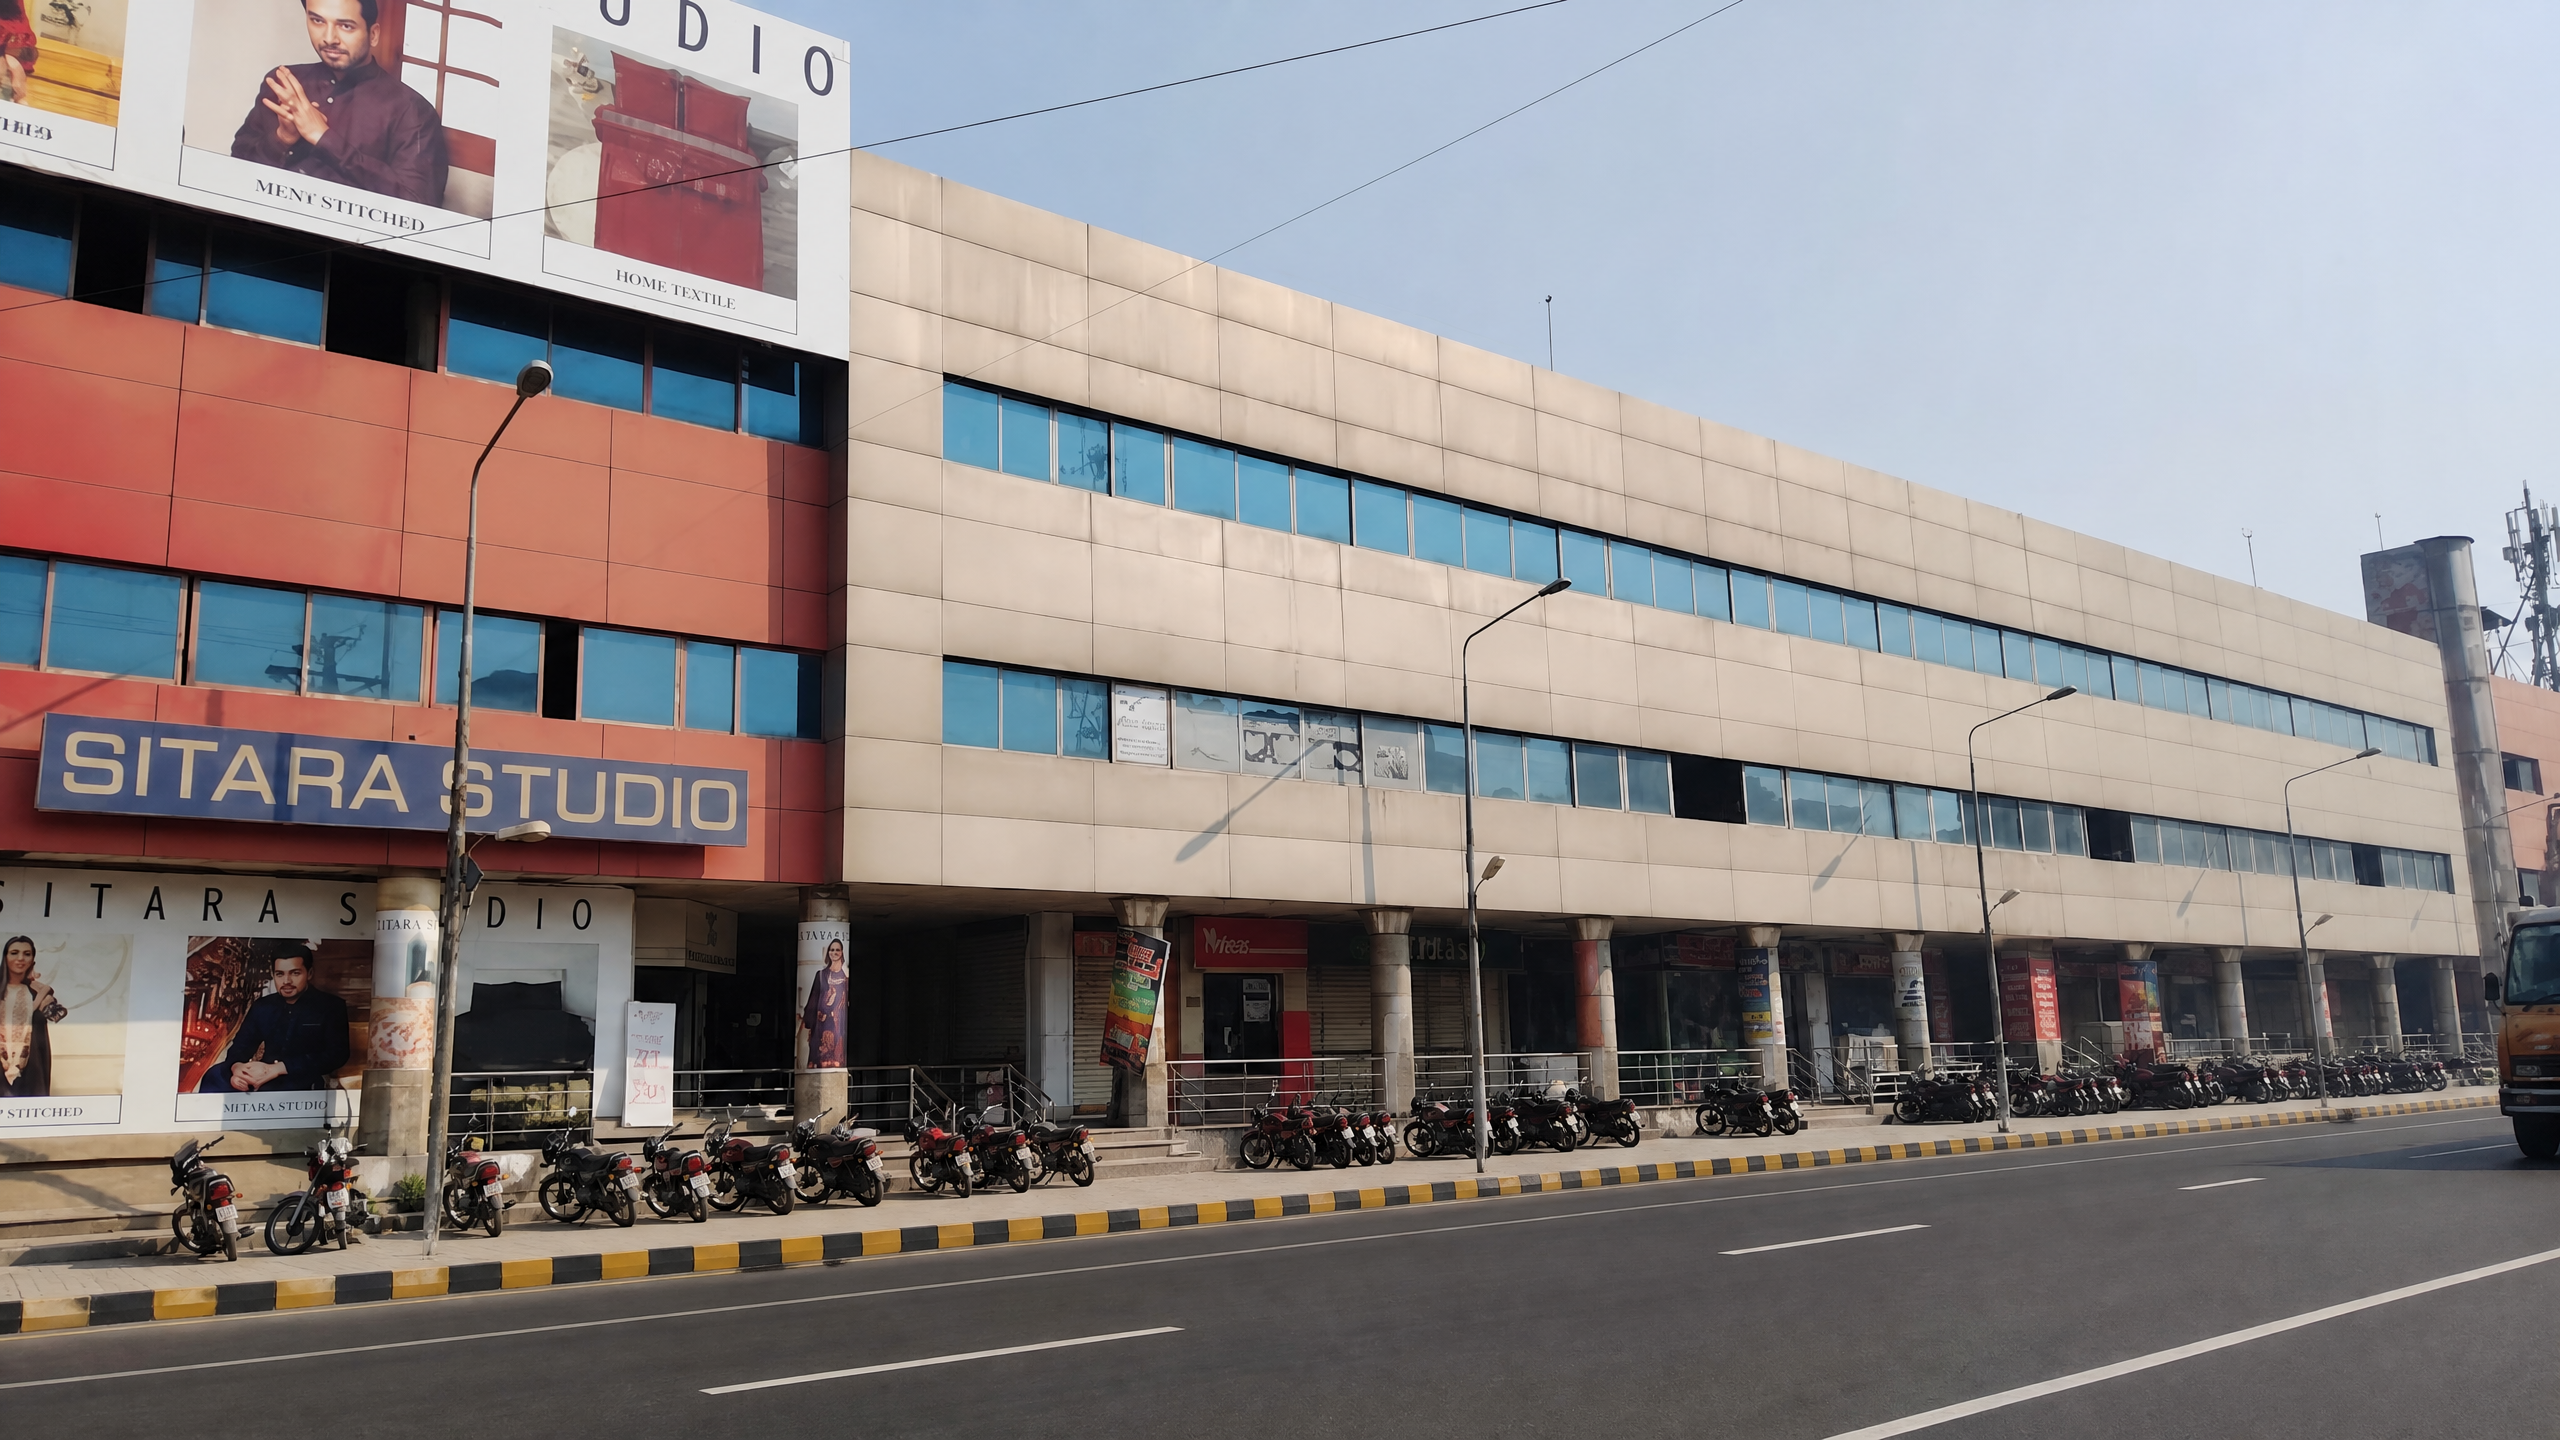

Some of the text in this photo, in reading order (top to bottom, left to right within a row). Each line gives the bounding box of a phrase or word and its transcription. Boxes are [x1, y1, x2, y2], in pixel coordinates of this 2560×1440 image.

[321, 195, 425, 232] STITCHED
[616, 269, 736, 310] HOME TEXTILE
[63, 731, 737, 831] SITARA STUDIO
[7, 1107, 83, 1119] STITCHED
[278, 1100, 328, 1111] STUDIO
